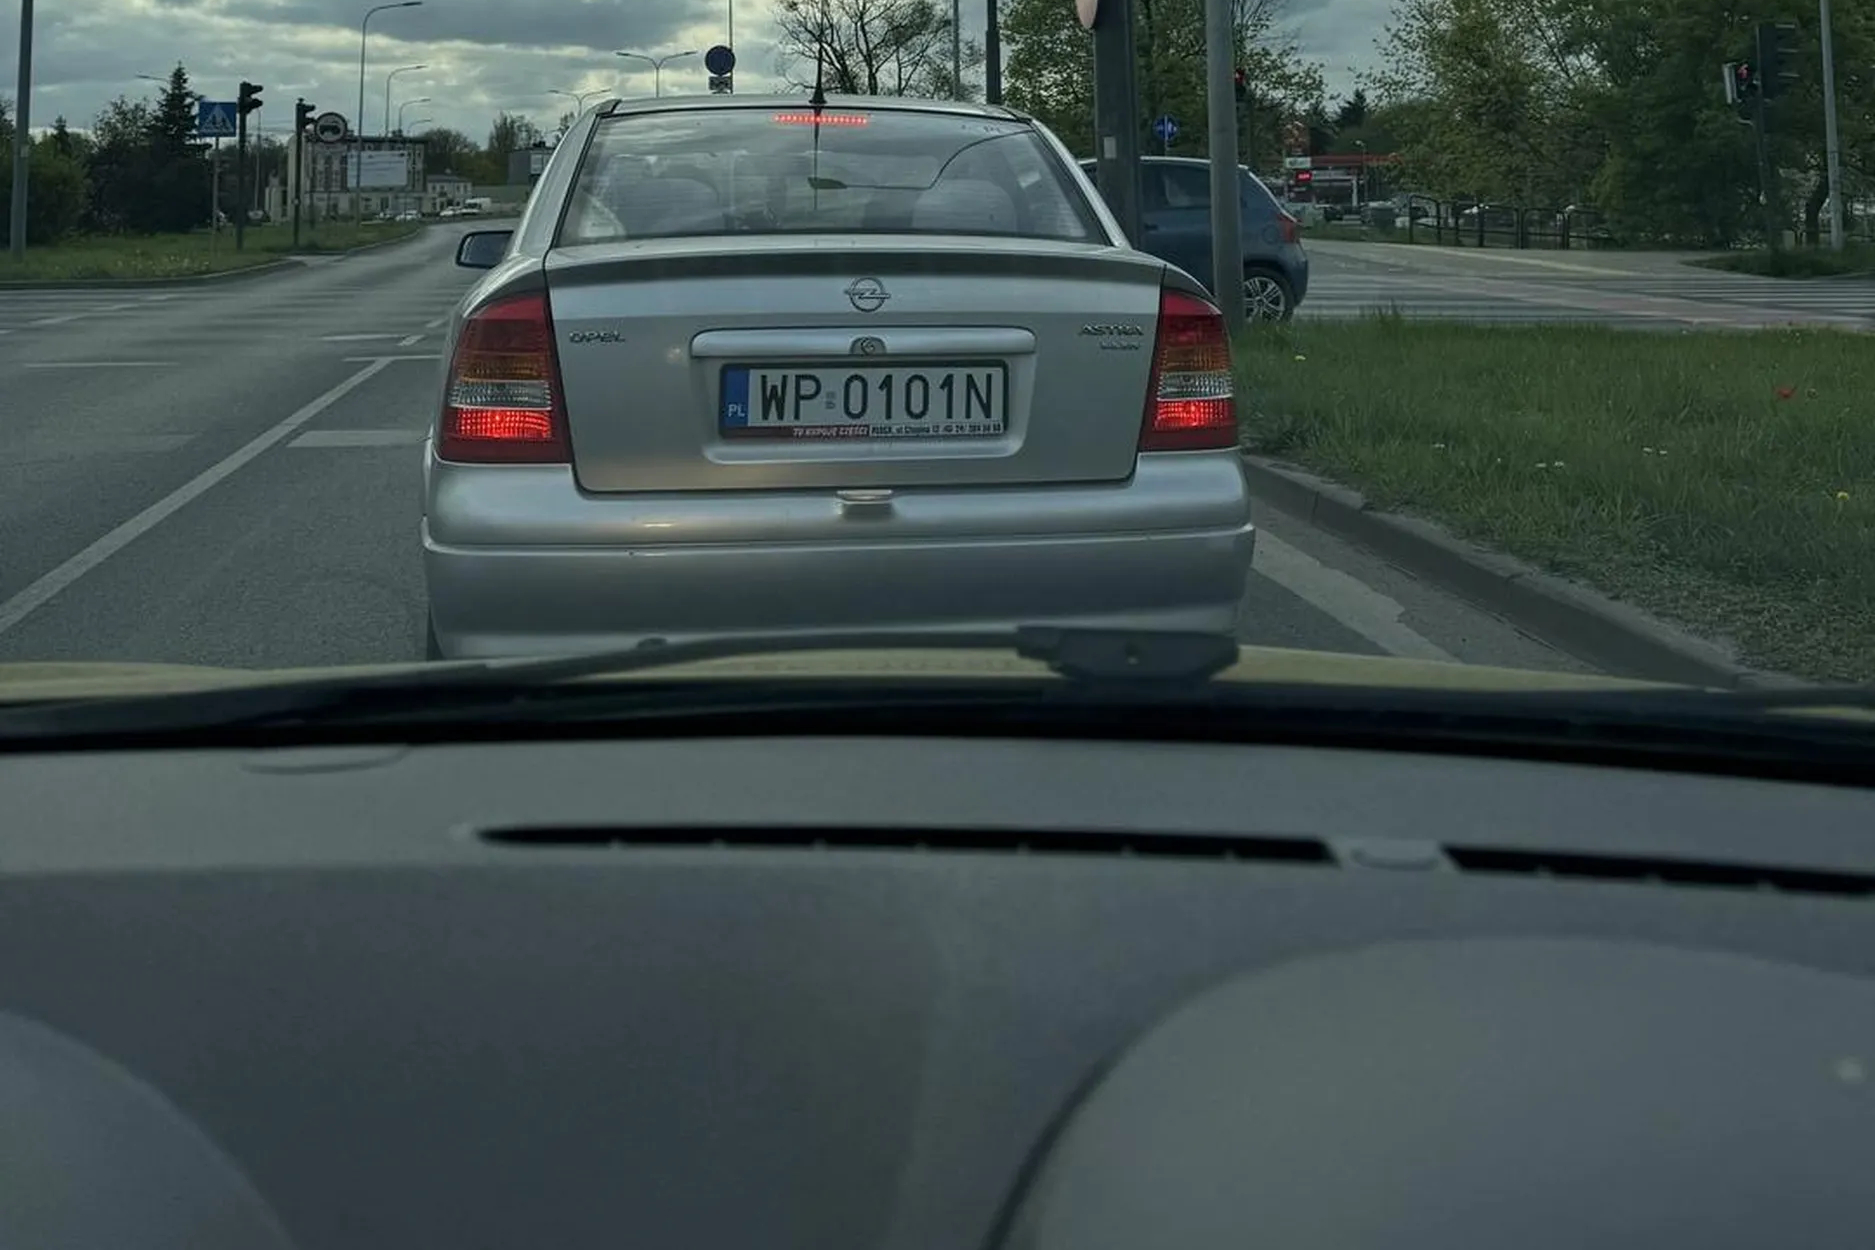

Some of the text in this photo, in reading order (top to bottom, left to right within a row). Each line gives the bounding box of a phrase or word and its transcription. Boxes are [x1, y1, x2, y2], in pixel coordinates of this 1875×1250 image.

[1079, 324, 1143, 335] ASTRA
[570, 330, 625, 344] OPEL
[761, 373, 993, 421] WP 0101N
[728, 403, 746, 418] PL
